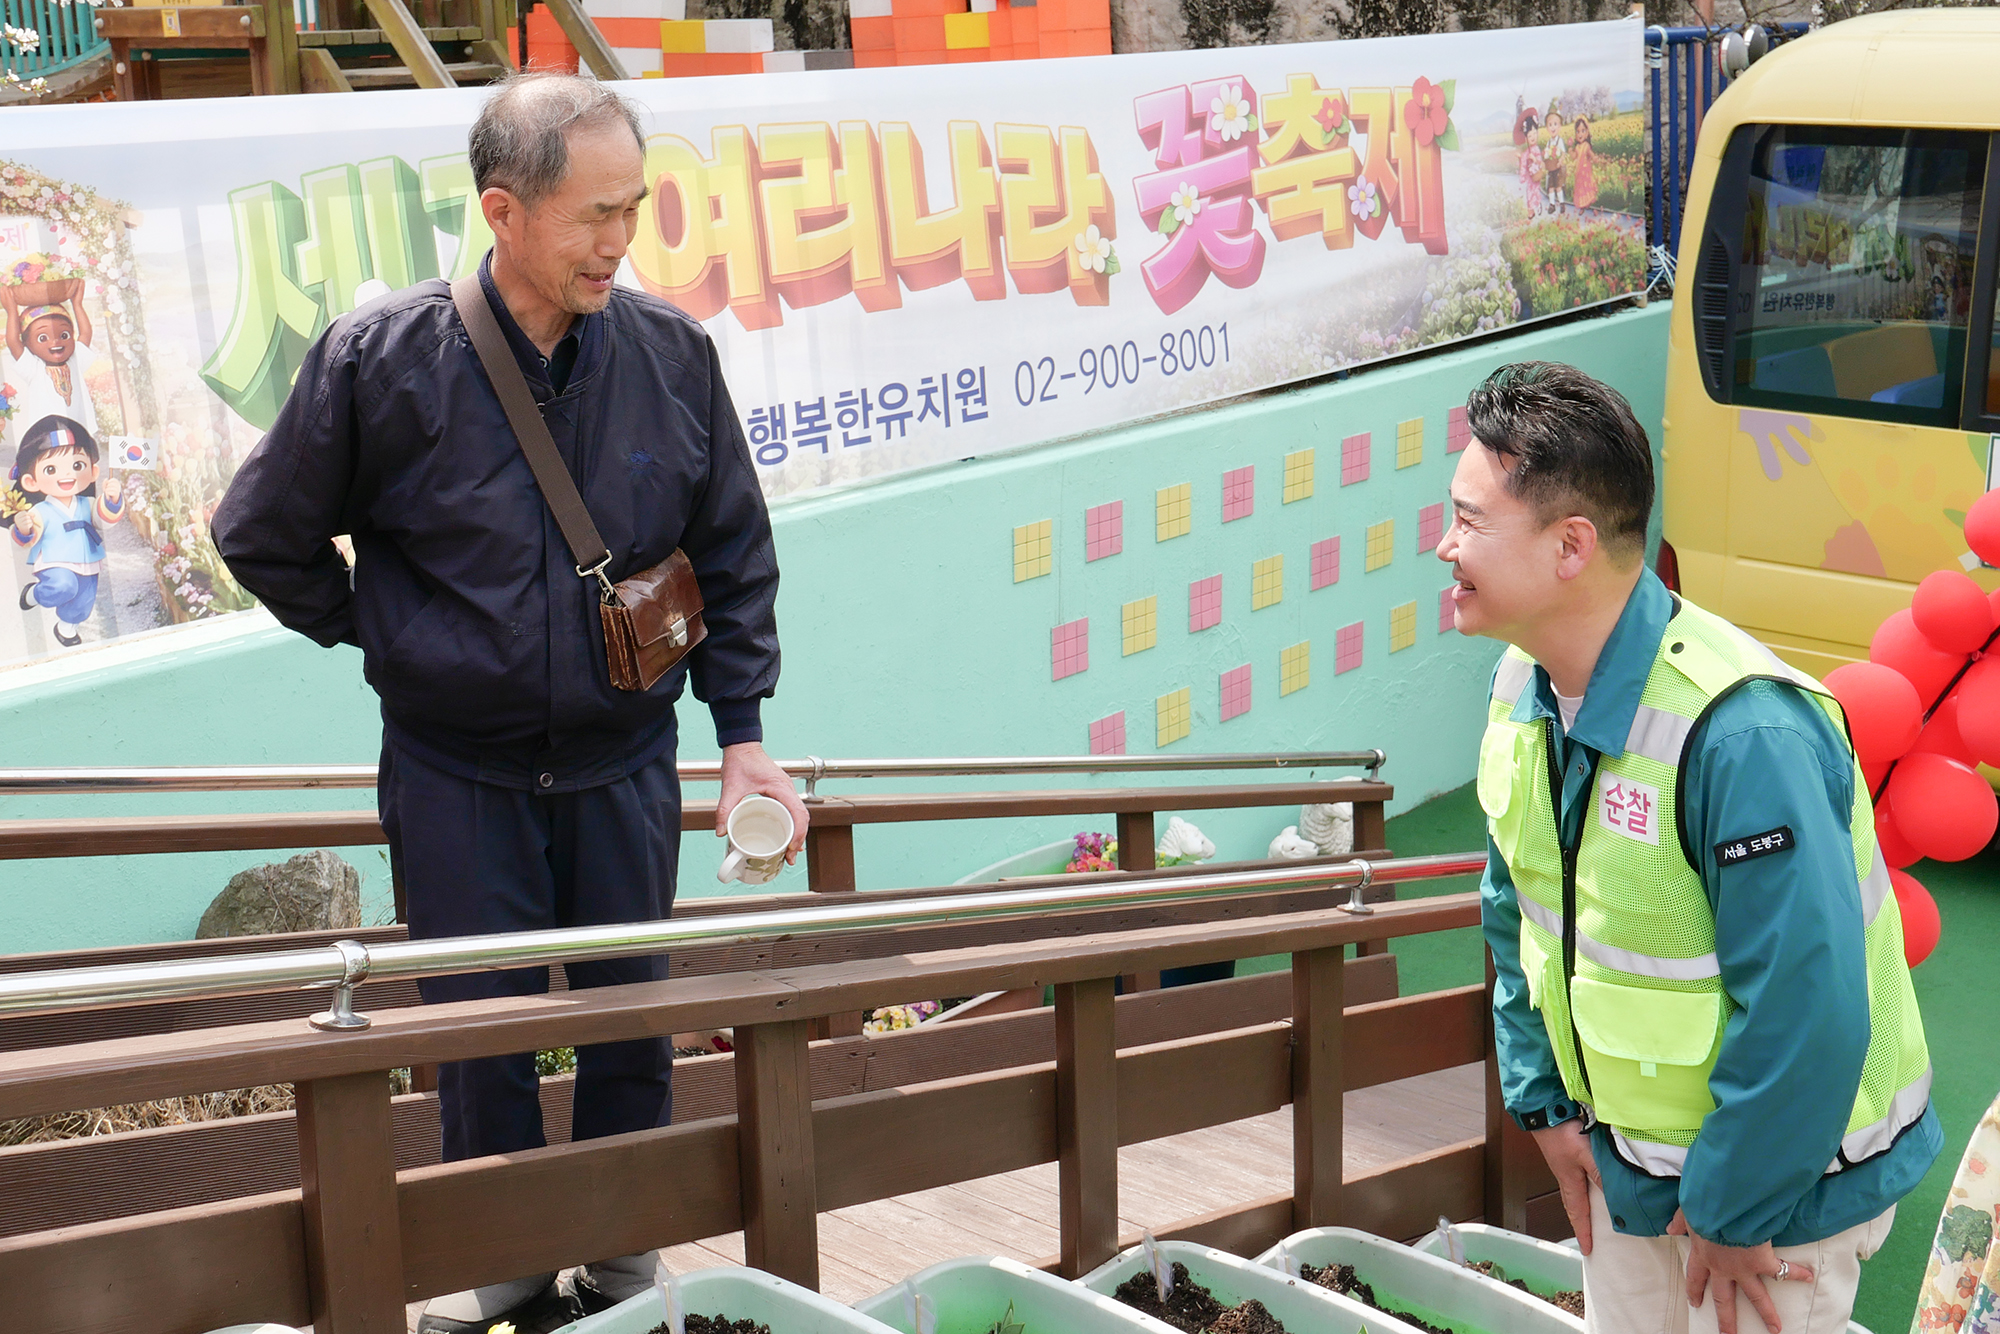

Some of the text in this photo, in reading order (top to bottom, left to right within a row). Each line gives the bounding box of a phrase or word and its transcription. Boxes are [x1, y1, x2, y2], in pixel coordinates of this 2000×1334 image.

[747, 321, 1230, 466] 행복한유치원 02-900-8001
[1605, 783, 1651, 835] 순찰
[1724, 832, 1785, 860] 서울 도봉구
